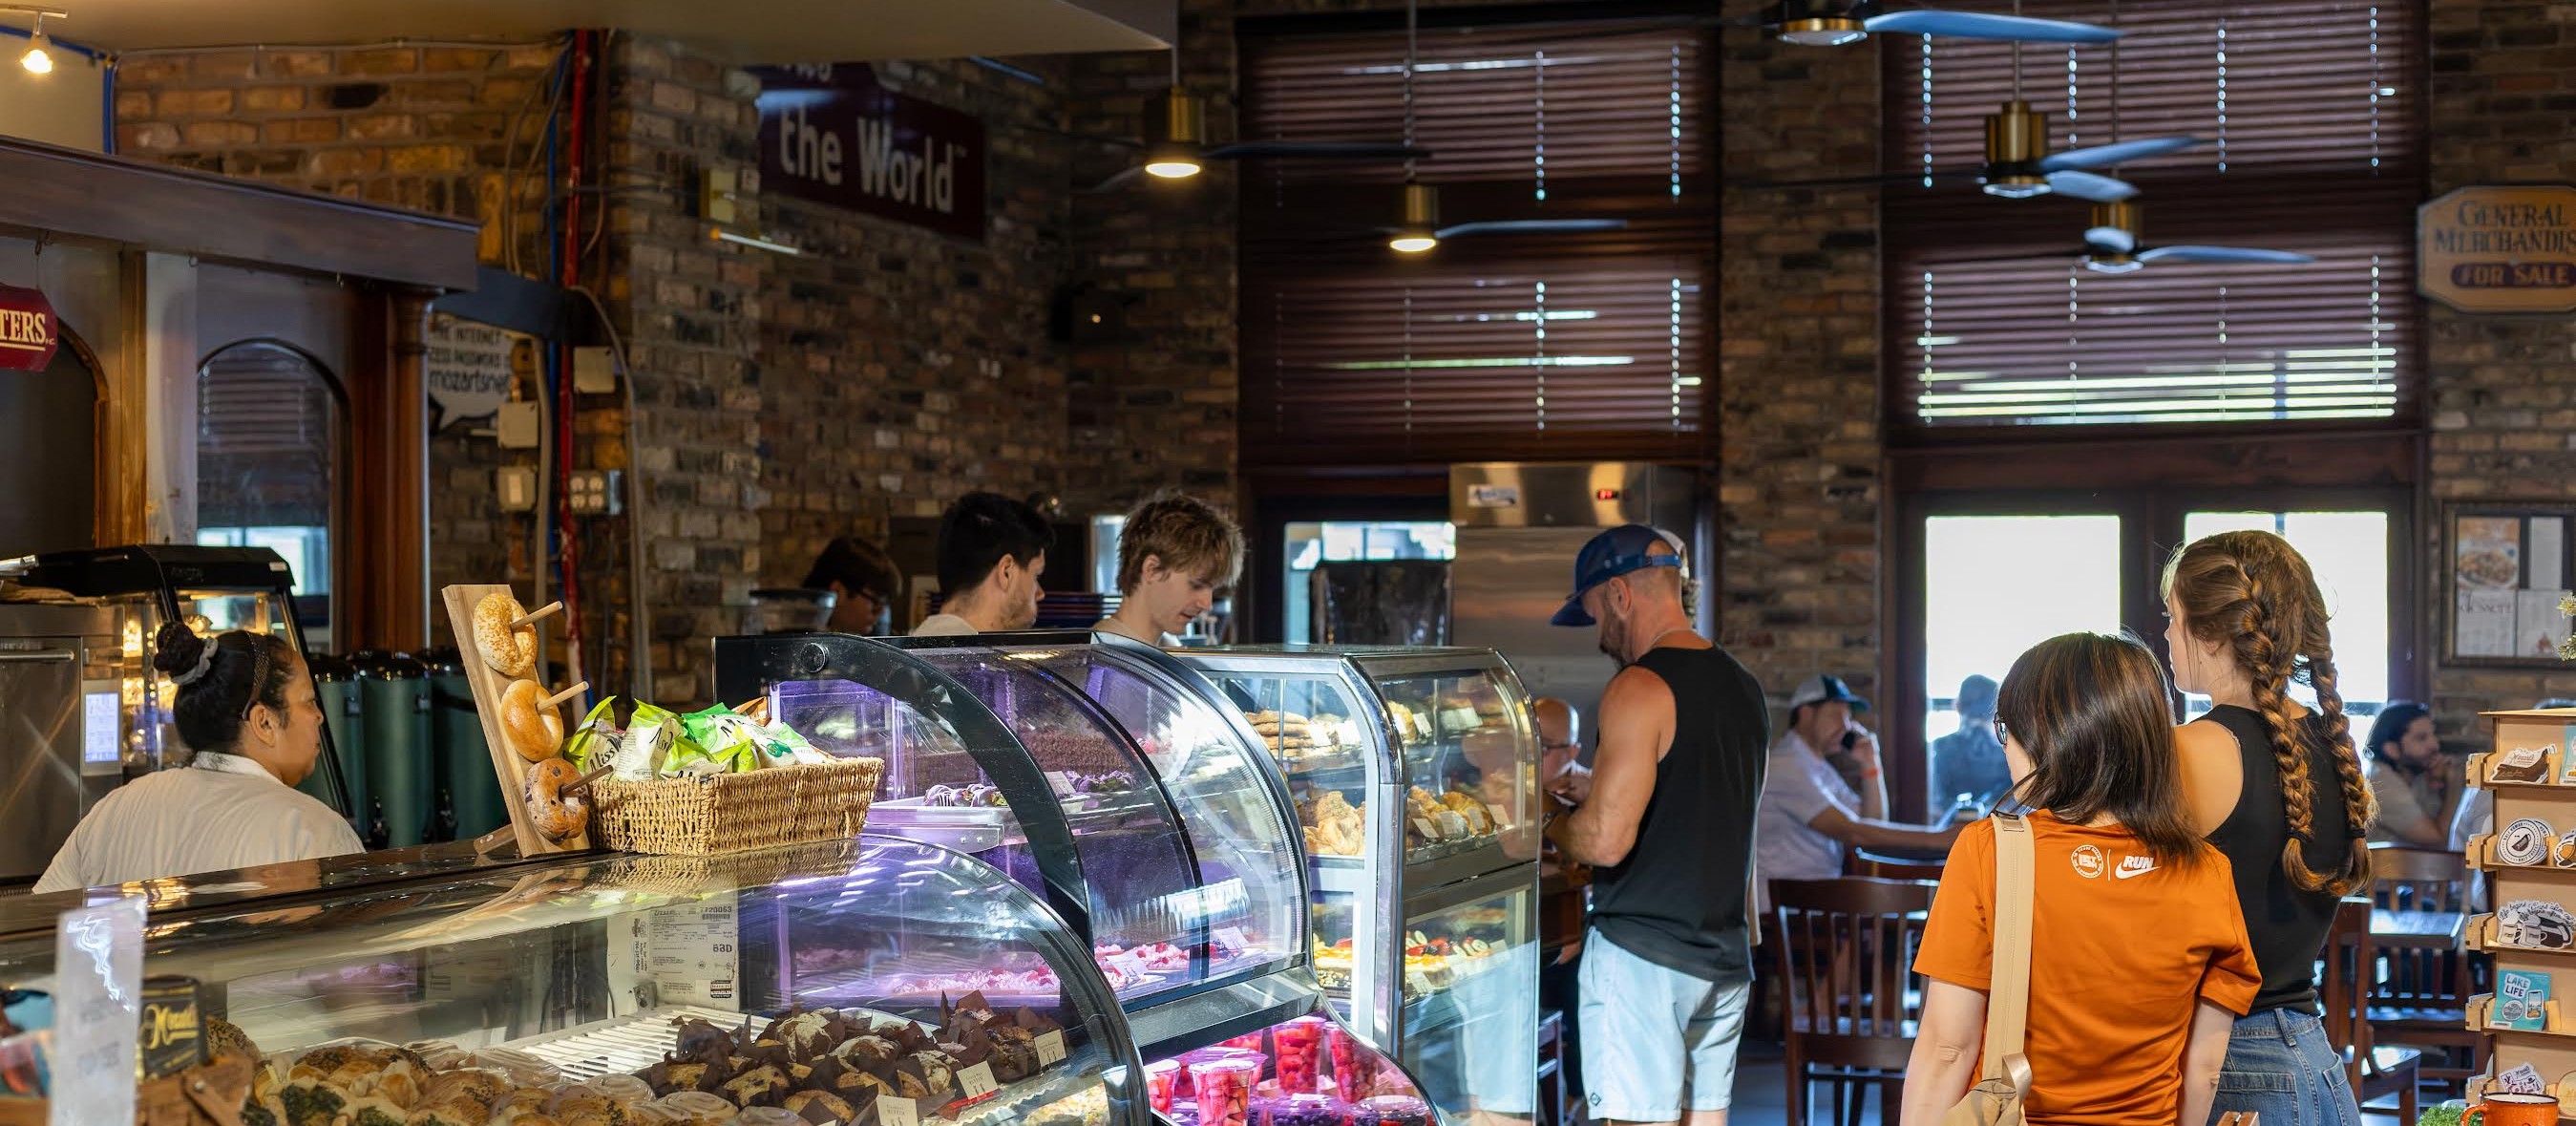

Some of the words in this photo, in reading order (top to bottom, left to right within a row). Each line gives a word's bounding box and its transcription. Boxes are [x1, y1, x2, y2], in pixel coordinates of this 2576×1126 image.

[779, 101, 842, 185] the
[857, 116, 953, 213] World
[2460, 265, 2504, 286] FOR
[2514, 265, 2567, 286] SALE
[2122, 855, 2154, 869] RUN
[2506, 975, 2529, 988] LAKE
[2505, 985, 2523, 997] LIFE
